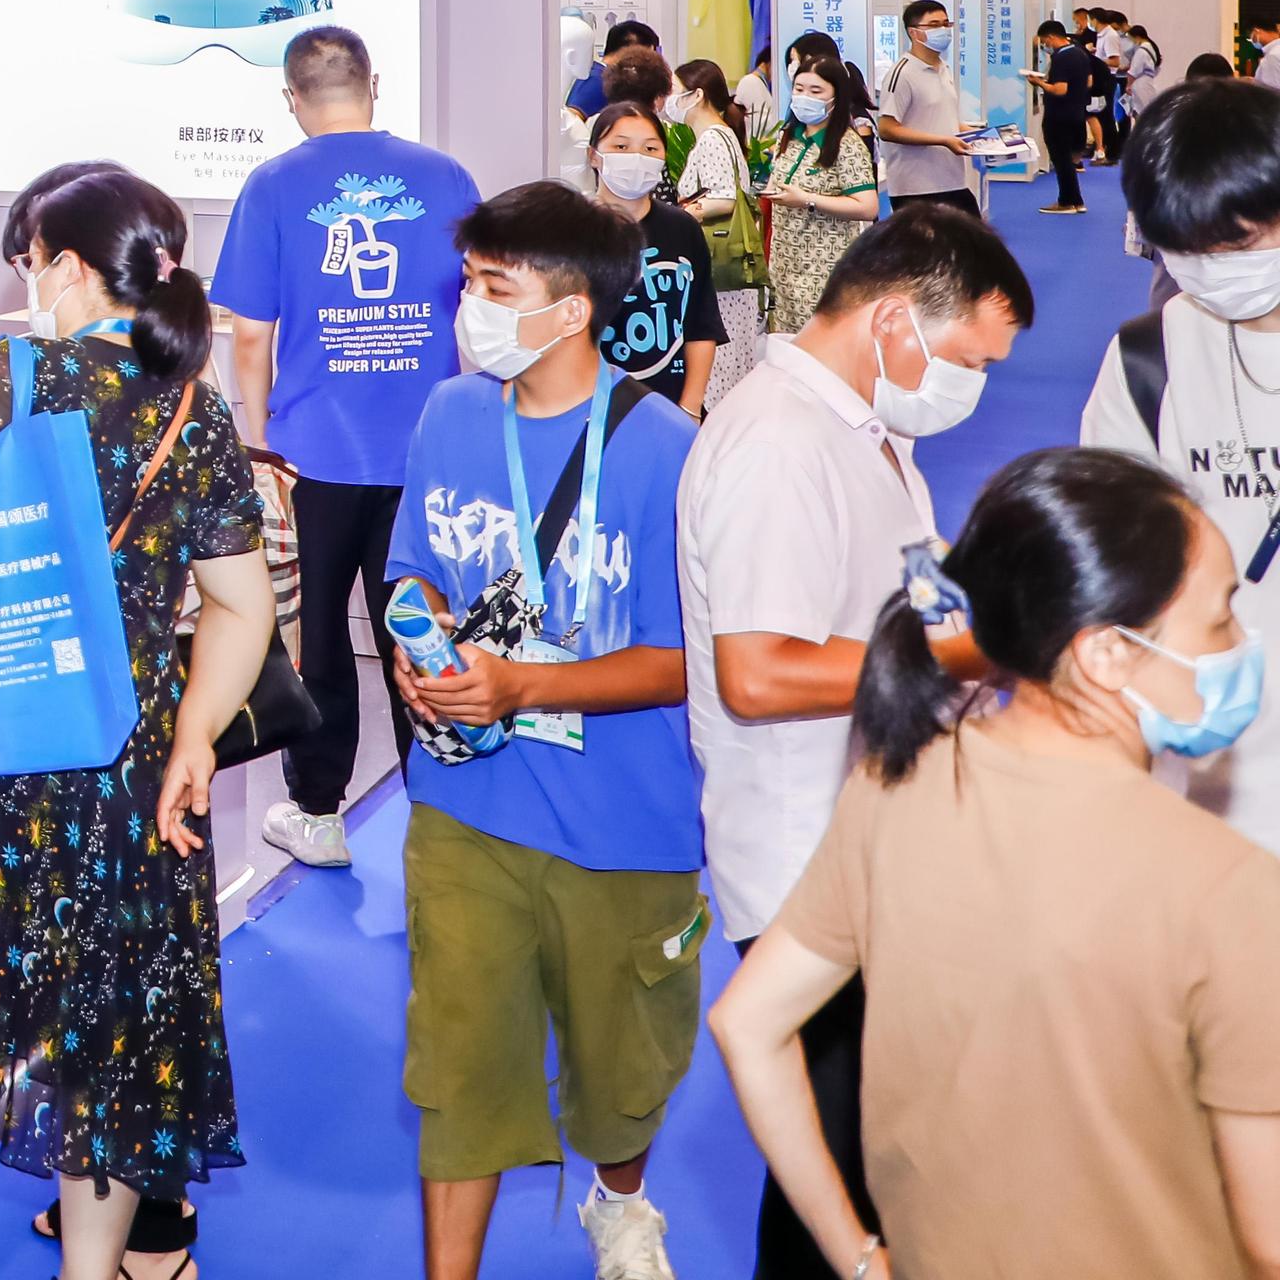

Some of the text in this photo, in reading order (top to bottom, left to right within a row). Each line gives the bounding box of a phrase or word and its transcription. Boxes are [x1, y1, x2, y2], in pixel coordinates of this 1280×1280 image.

[987, 14, 996, 40] China
[987, 42, 996, 65] 2022
[178, 126, 265, 145] 眼部按摩仪
[174, 150, 197, 164] Eye
[318, 303, 431, 323] PREMIUM STYLE
[329, 358, 419, 372] SUPER PLANTS
